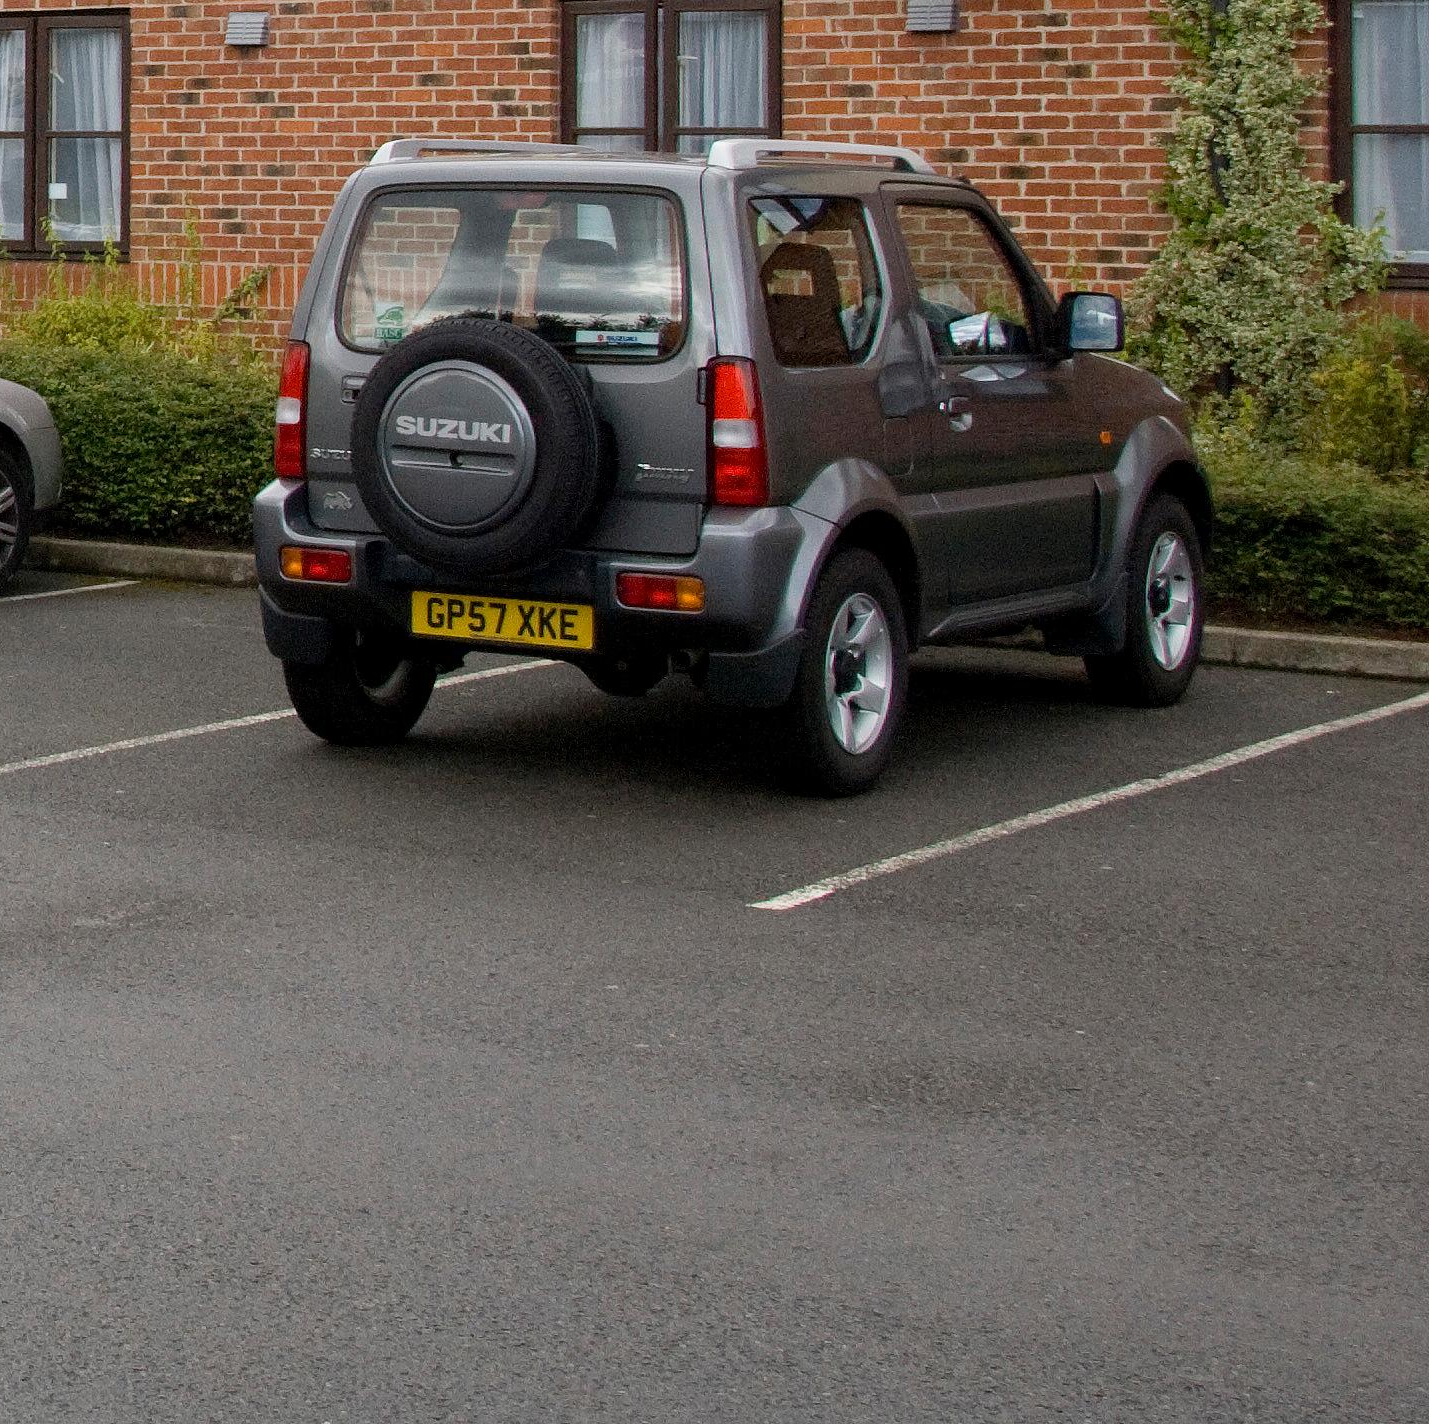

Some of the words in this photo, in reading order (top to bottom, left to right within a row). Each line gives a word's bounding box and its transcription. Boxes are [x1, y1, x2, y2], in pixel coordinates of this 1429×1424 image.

[395, 415, 511, 443] SUZUKI
[427, 597, 507, 633] GP57
[518, 605, 579, 641] XKE
